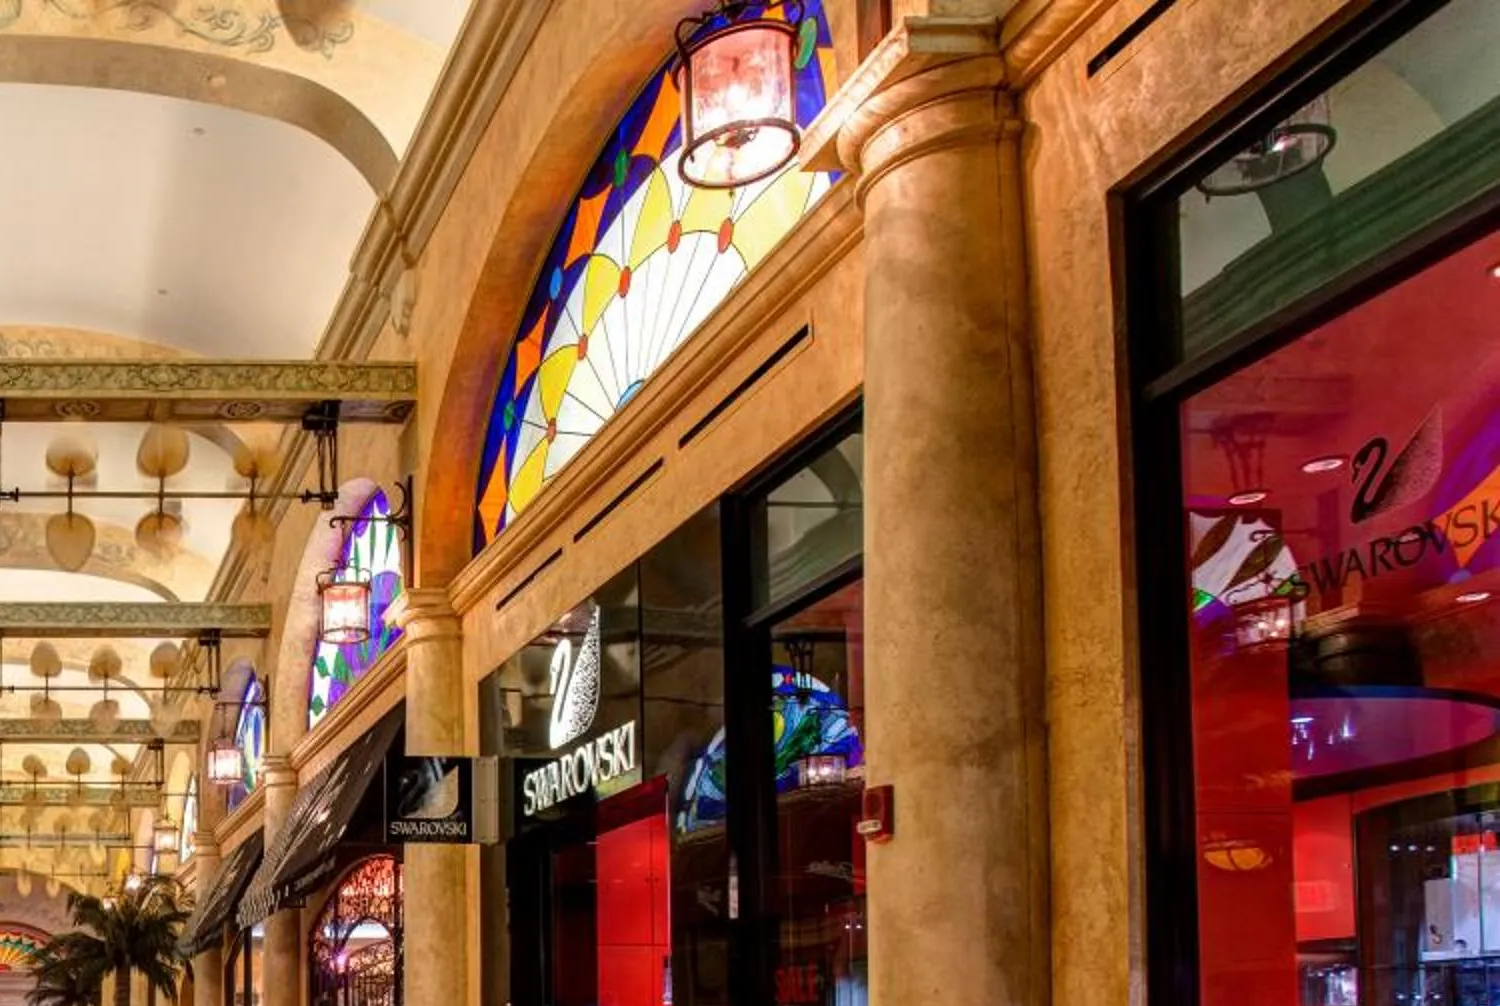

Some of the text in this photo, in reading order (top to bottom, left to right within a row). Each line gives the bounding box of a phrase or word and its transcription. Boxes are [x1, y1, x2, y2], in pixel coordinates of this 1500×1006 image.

[1291, 499, 1500, 599] SWAROVSK
[523, 719, 636, 817] SWAROVSKI
[389, 821, 467, 836] SWAROVSKI
